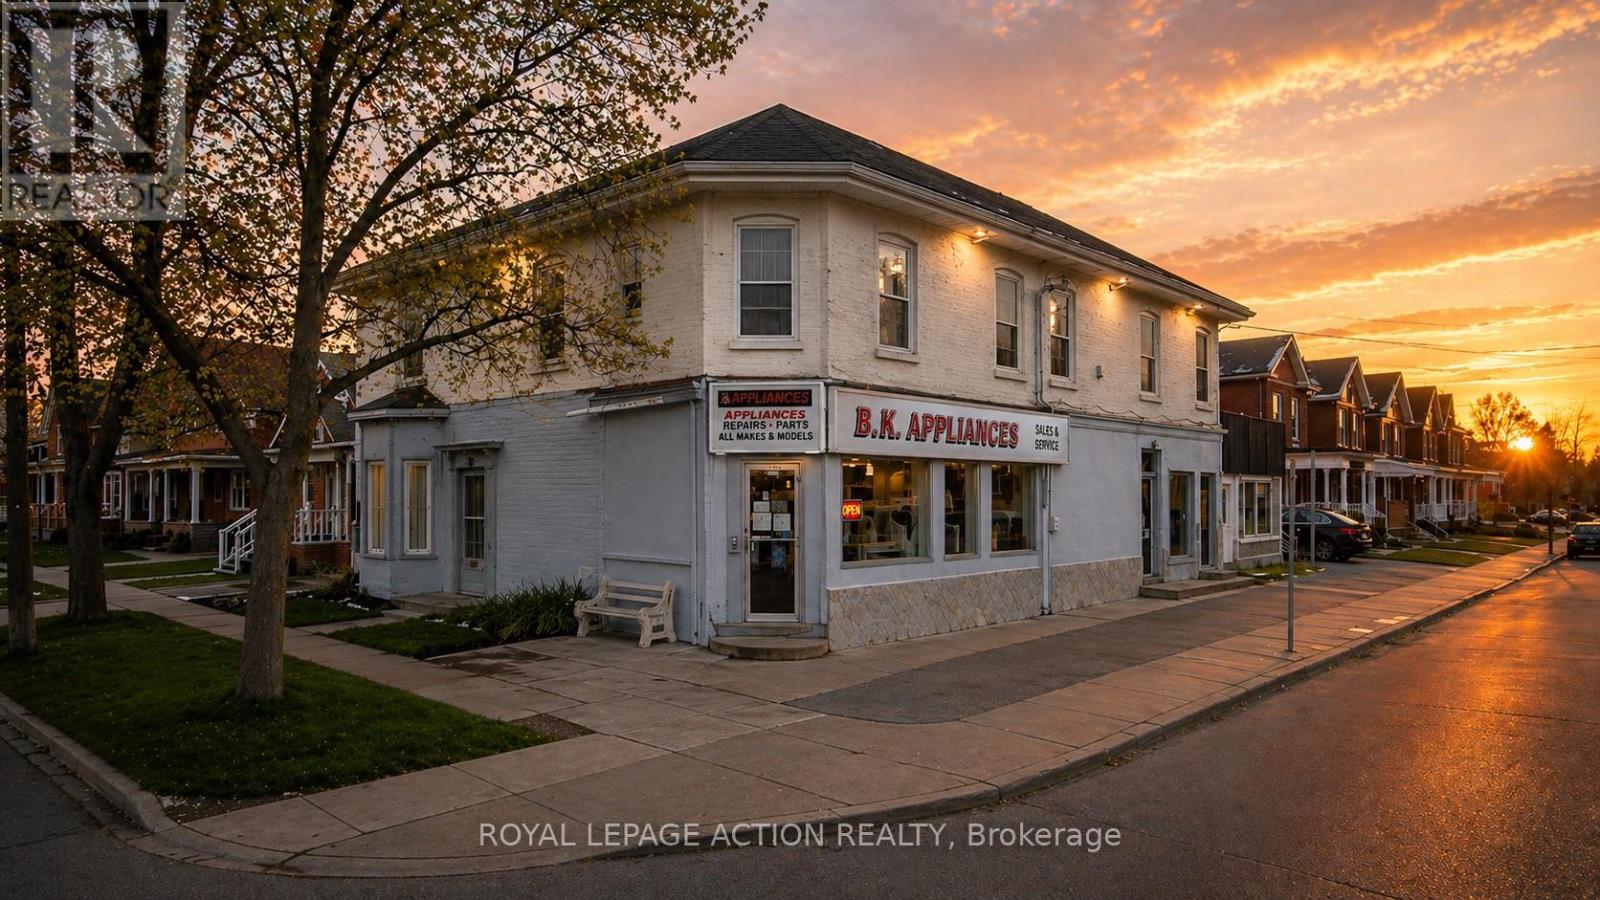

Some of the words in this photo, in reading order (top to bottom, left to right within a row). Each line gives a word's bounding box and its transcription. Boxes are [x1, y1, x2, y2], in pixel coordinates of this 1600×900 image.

[731, 391, 810, 404] APPLIANCES
[724, 410, 806, 420] APPLIANCES
[723, 421, 767, 430] REPAIRS
[776, 420, 809, 429] PARTS
[853, 405, 901, 440] B.K.
[905, 411, 1019, 449] APPLIANCES
[1035, 424, 1053, 437] SALES
[1054, 426, 1059, 437] &
[719, 432, 734, 441] ALL
[736, 432, 766, 441] MAKES
[768, 432, 775, 441] &
[777, 431, 814, 441] MODELS
[1034, 438, 1060, 452] SERVICE
[842, 504, 861, 516] OPEN
